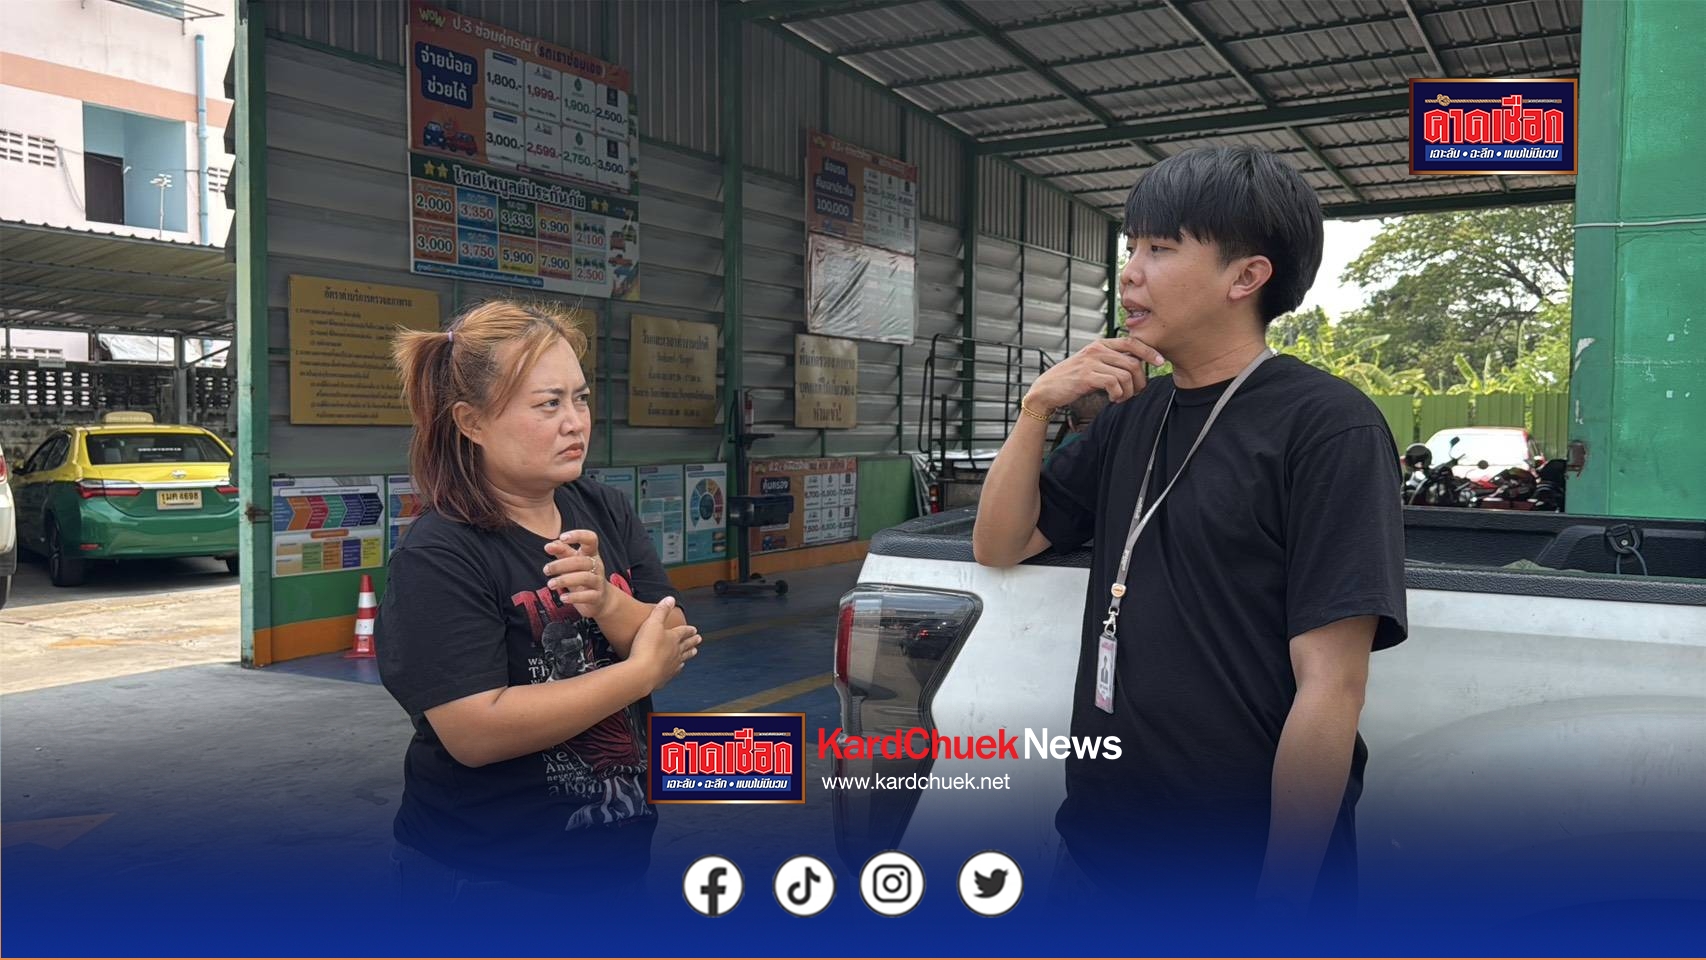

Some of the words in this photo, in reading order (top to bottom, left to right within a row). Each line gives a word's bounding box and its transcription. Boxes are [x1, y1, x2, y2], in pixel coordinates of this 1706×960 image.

[420, 45, 473, 76] จ่ายน้อย
[427, 77, 468, 102] ช่วยได้
[486, 72, 522, 91] 1,800.-
[453, 165, 586, 210] ไทยไพบูลย์ประกันภัย
